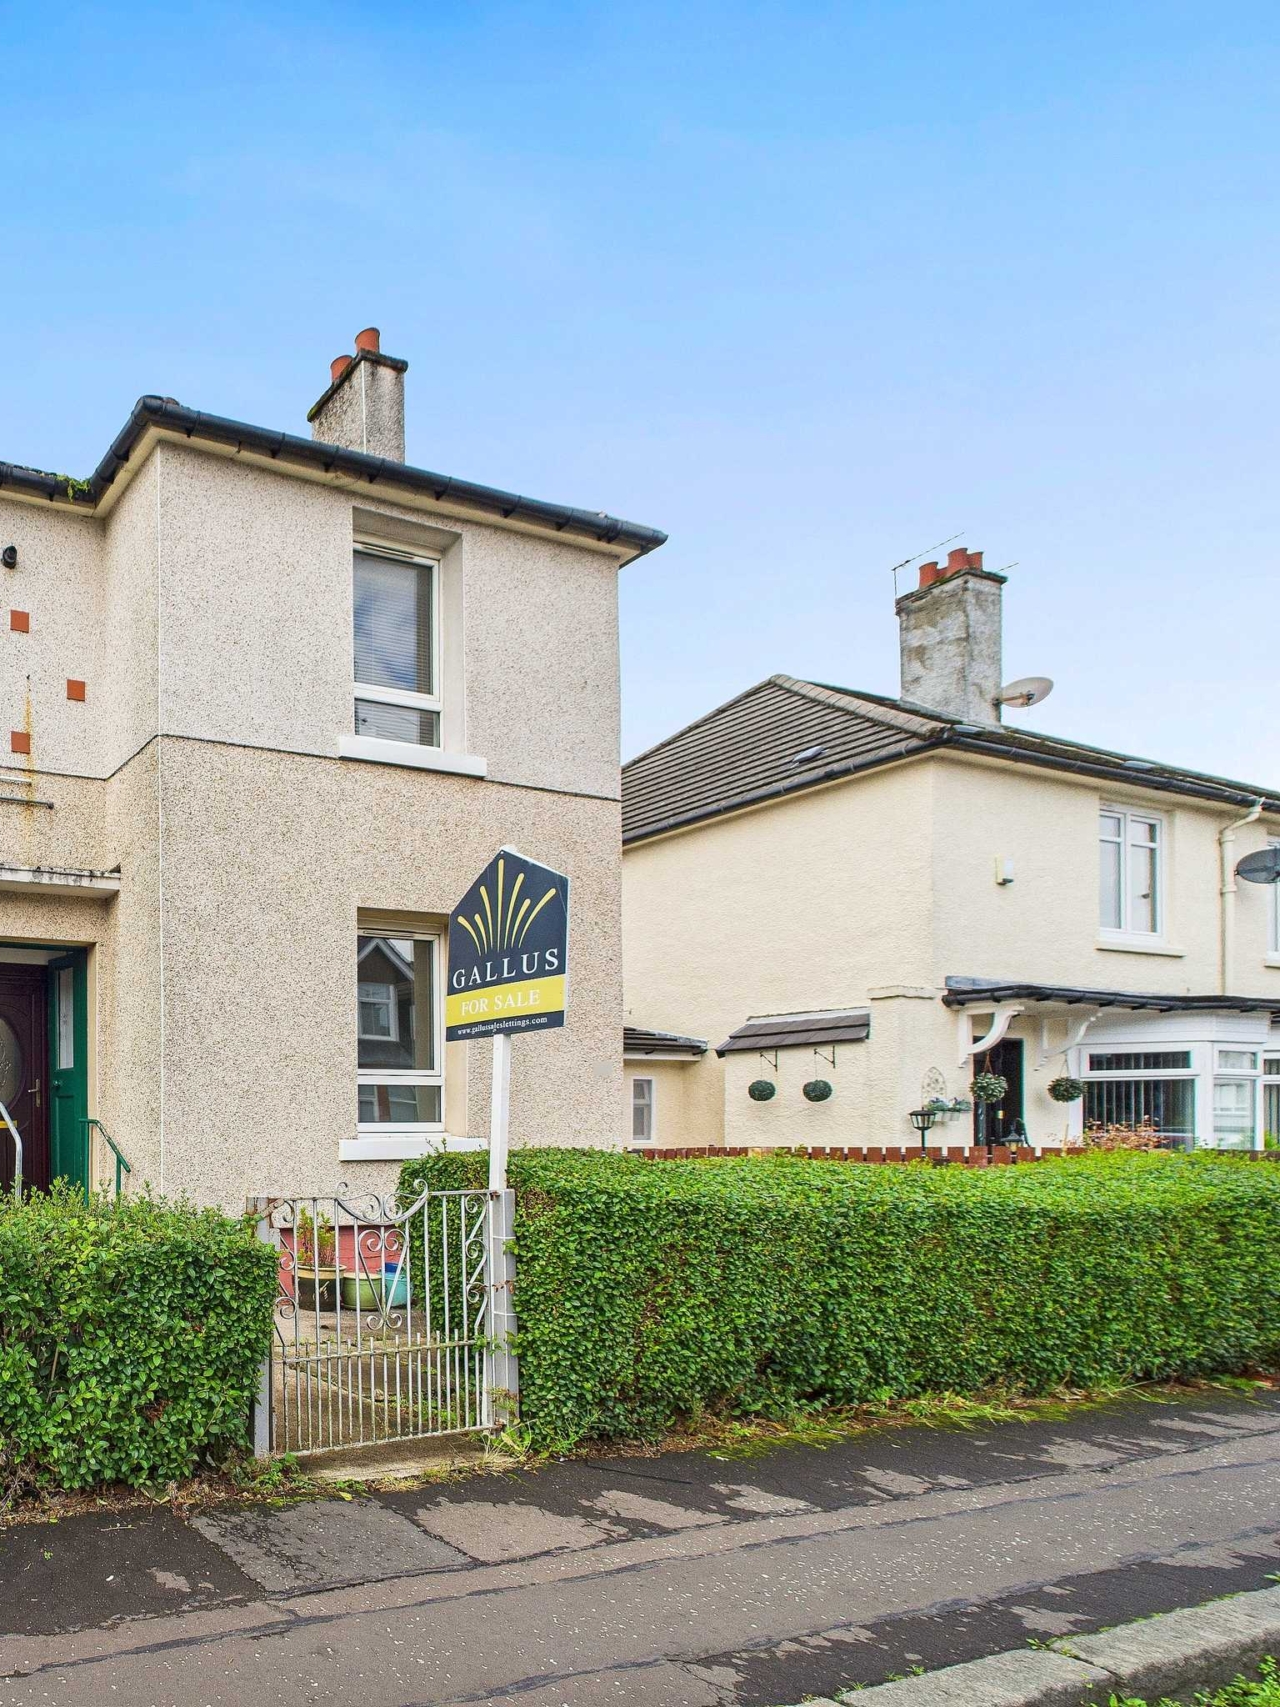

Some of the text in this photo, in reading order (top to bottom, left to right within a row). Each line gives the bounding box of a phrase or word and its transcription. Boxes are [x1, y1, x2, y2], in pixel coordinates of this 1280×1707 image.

[452, 948, 559, 989] GALLUS
[461, 989, 540, 1016] FOR SALE
